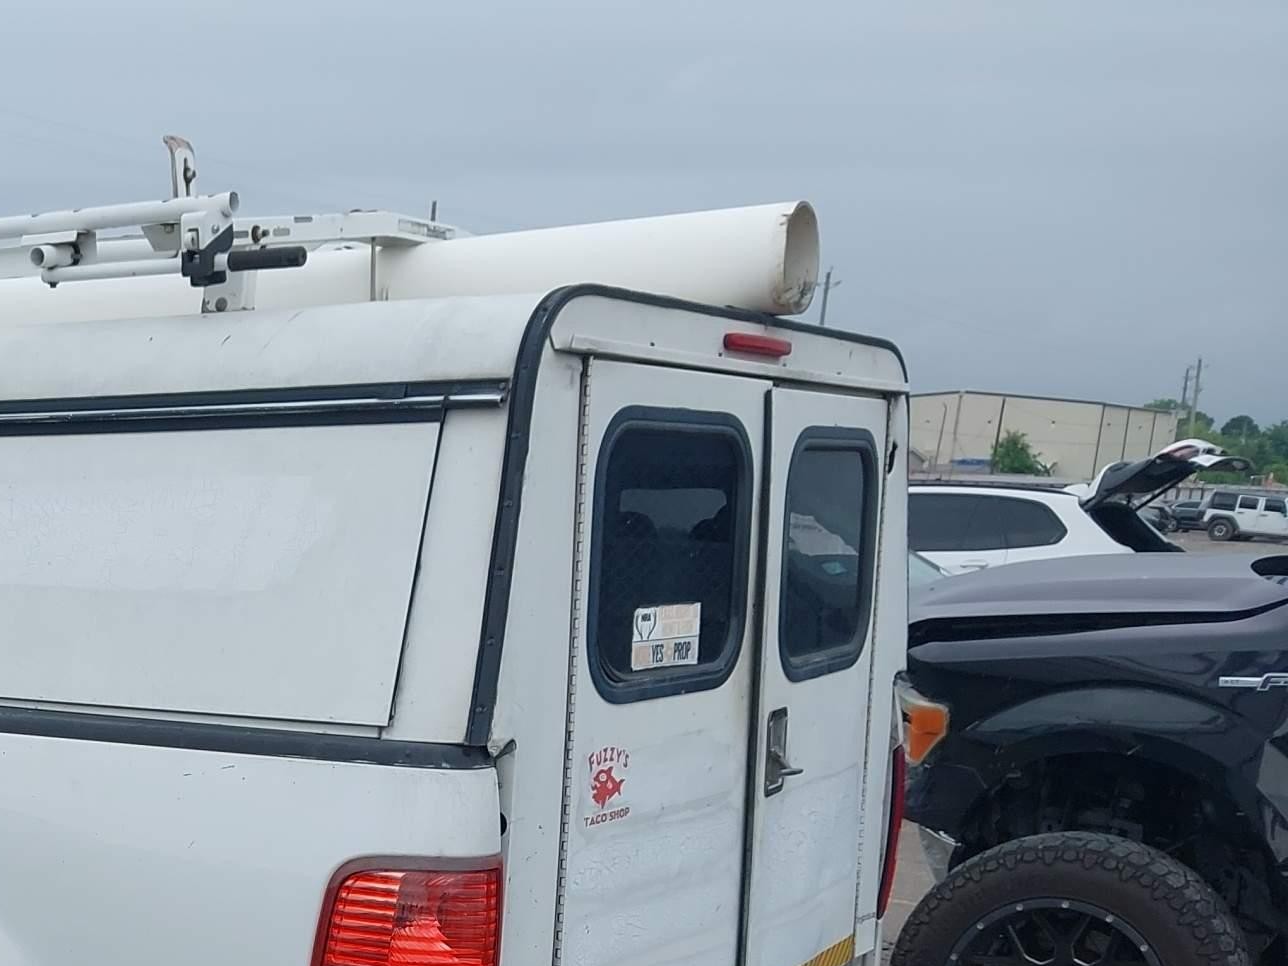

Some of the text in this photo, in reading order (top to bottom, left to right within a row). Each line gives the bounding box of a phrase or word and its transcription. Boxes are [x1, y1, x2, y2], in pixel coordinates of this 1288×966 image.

[652, 643, 664, 663] YES
[673, 641, 691, 660] PROP
[588, 746, 630, 772] FUZZY'S
[584, 807, 630, 827] TACO SHOP
